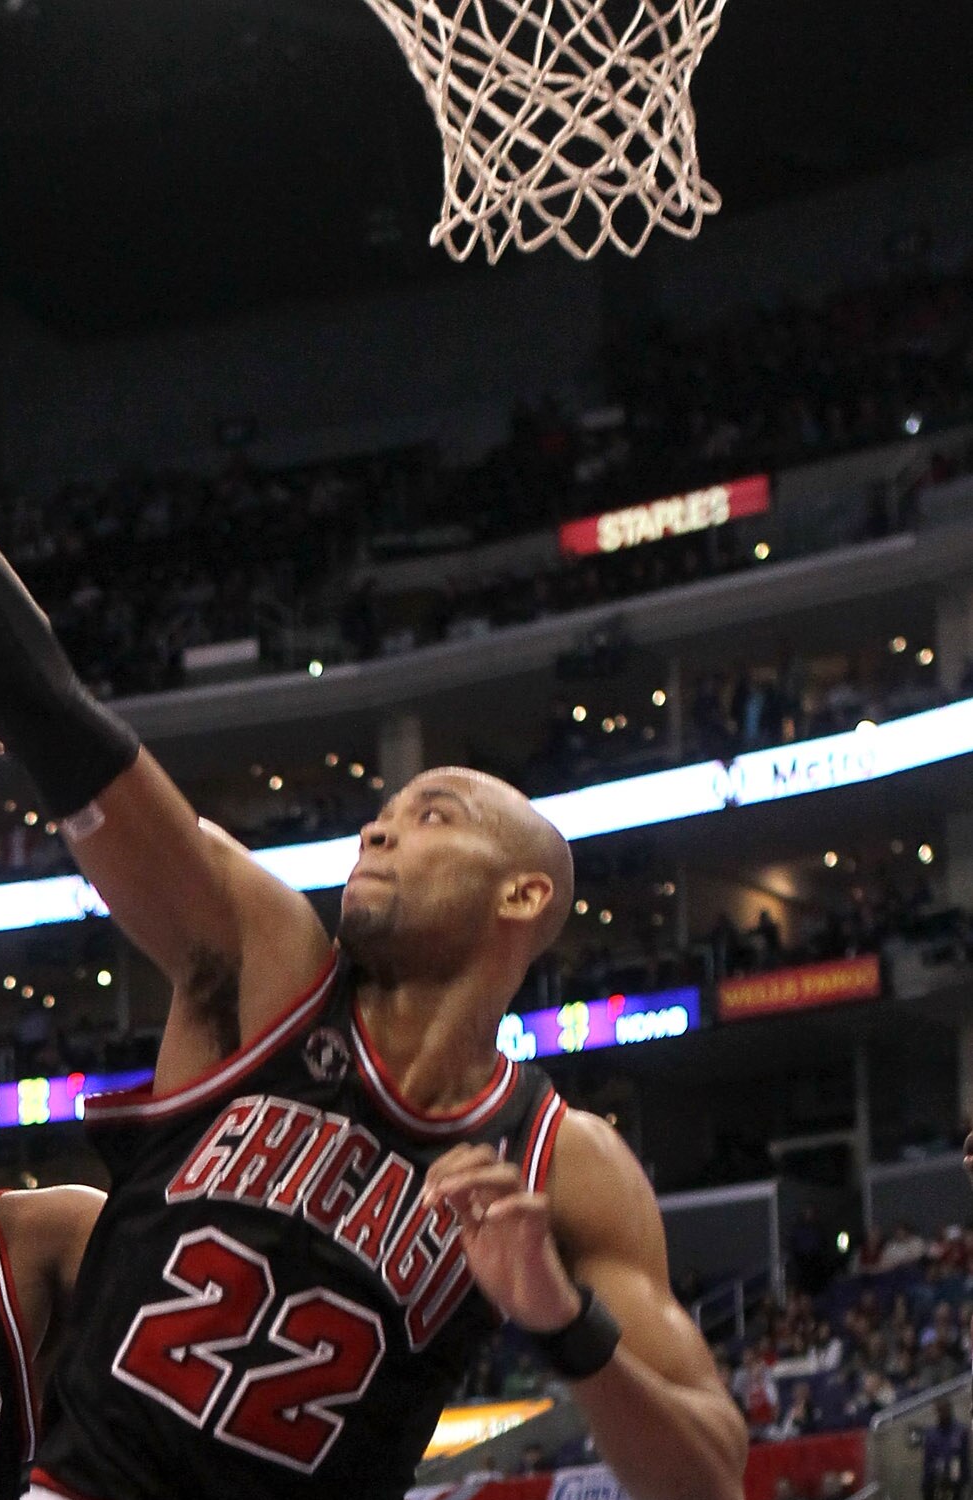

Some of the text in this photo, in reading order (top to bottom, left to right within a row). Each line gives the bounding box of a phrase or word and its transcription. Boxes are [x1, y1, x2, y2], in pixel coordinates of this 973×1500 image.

[597, 485, 730, 553] STAPLES
[165, 1094, 477, 1352] CHICAGO
[112, 1225, 386, 1474] 22
